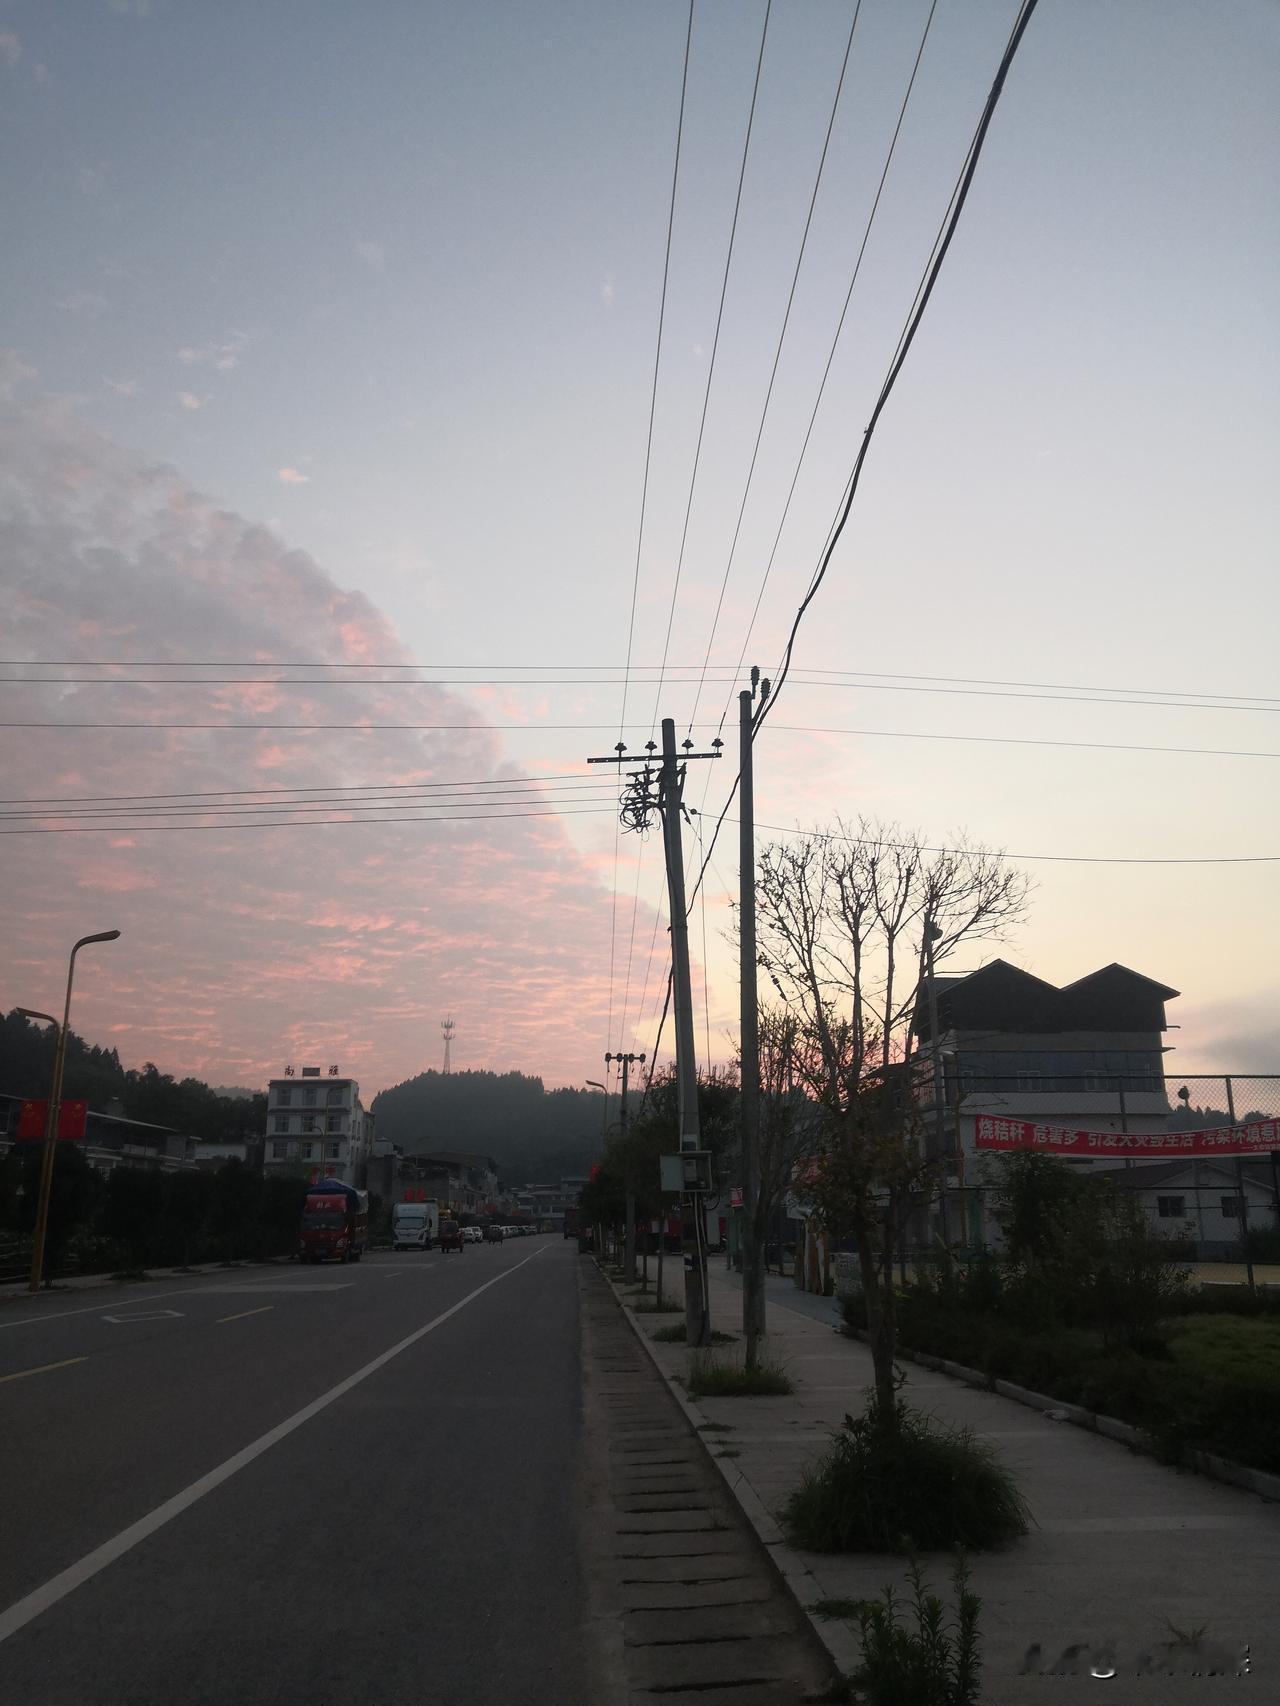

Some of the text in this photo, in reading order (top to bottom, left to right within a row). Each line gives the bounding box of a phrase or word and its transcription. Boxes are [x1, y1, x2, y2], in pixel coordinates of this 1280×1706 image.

[979, 1117, 1025, 1142] 烧秸秆
[1032, 1125, 1080, 1146] 危害多
